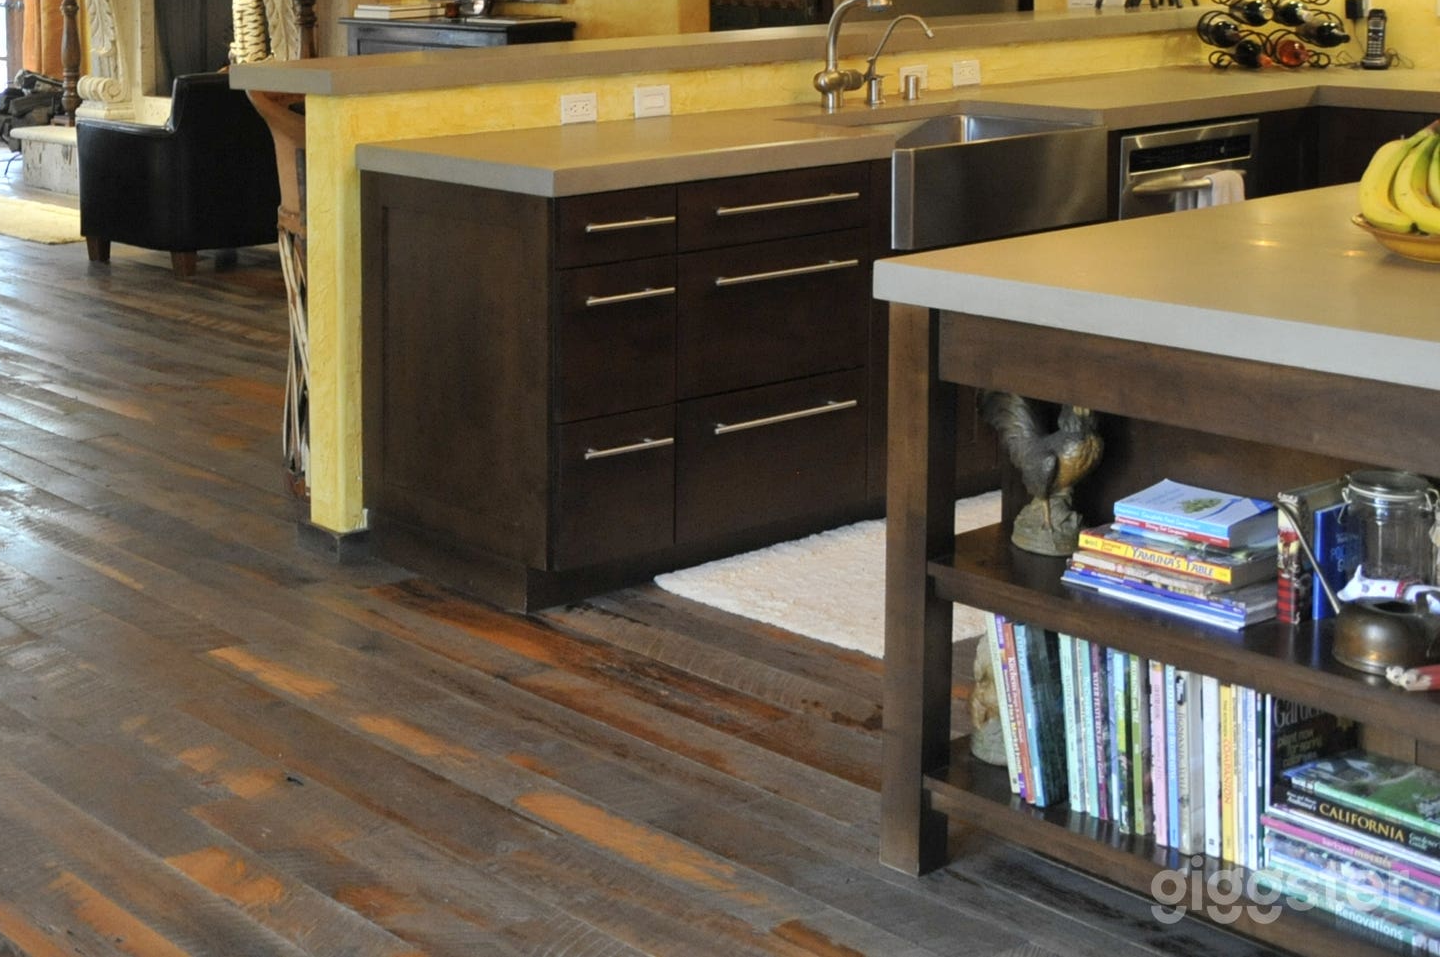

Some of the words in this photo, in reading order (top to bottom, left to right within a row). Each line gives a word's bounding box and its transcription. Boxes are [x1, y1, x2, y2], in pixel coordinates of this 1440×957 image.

[1186, 560, 1215, 577] TABLE
[1093, 672, 1101, 696] WATER
[1094, 698, 1102, 734] FEATURES
[1224, 739, 1233, 804] COMPANION
[1319, 802, 1405, 842] CALIFORNIA
[1335, 903, 1404, 941] Renovations
